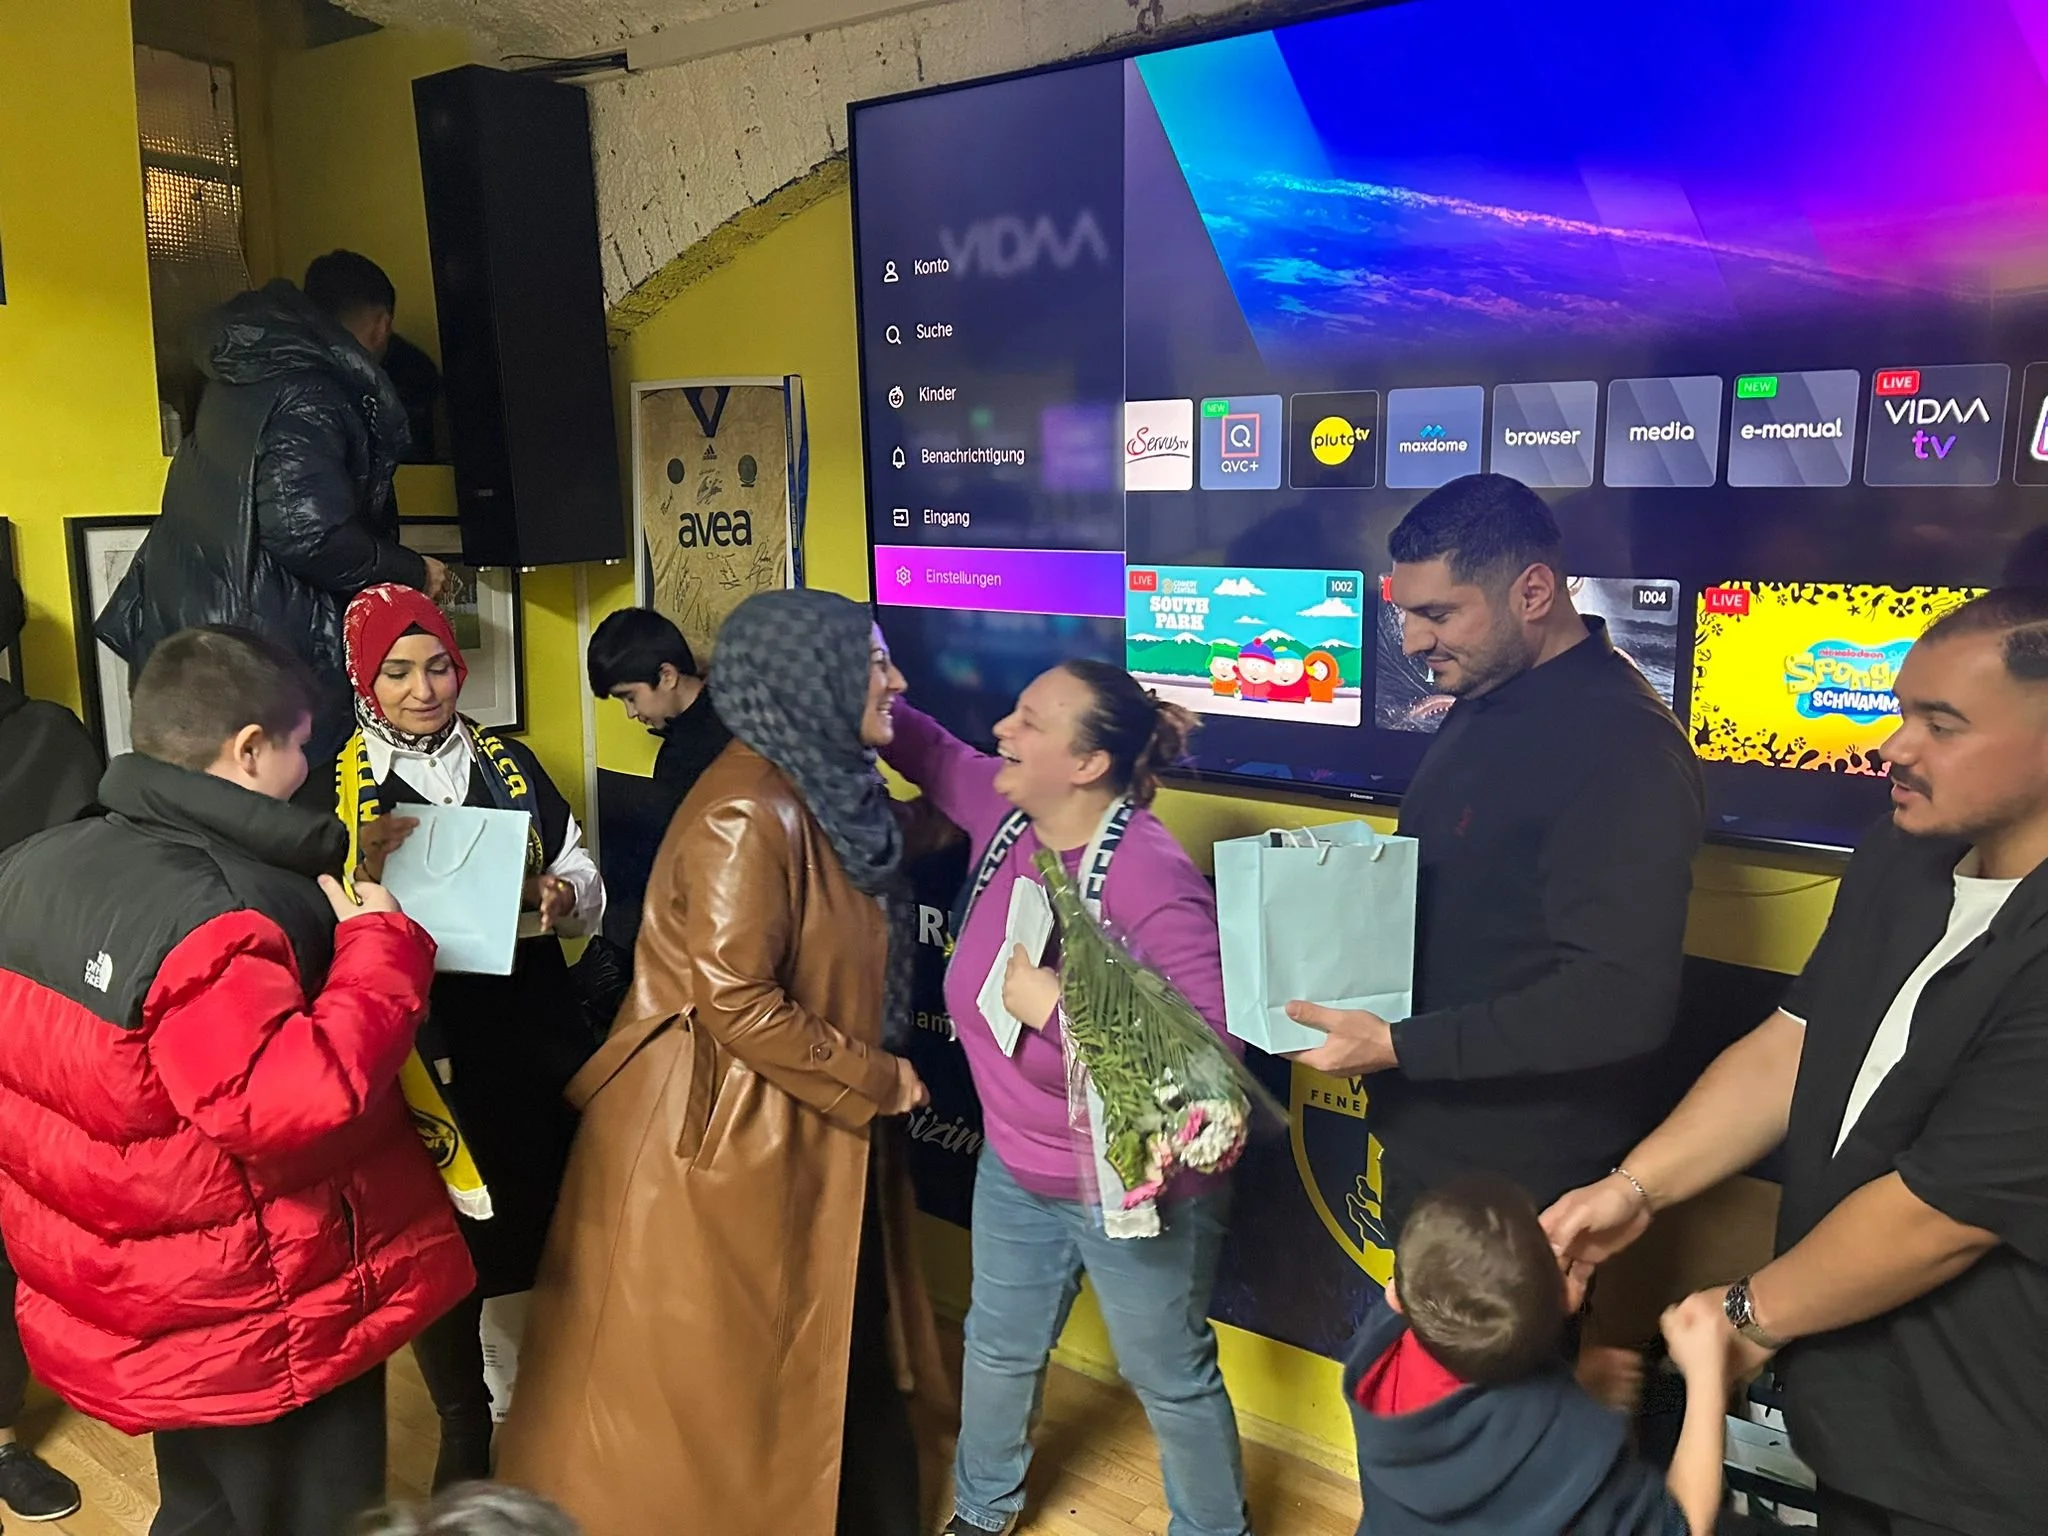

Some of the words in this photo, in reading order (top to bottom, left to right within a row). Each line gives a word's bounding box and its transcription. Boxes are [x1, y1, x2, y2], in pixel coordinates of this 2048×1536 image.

[914, 257, 949, 275] Konto
[916, 323, 953, 340] Suche
[1743, 380, 1772, 393] NEW
[1882, 375, 1913, 390] LIVE
[919, 385, 957, 402] Kinder
[1206, 403, 1226, 413] NEW
[1230, 424, 1251, 448] Q
[1504, 428, 1582, 447] browser
[1628, 421, 1695, 442] media
[1740, 418, 1843, 441] e-manual
[1314, 433, 1356, 450] pluto
[1399, 437, 1468, 453] maxdome
[1911, 429, 1957, 460] tv
[921, 446, 1026, 466] Benachrichtigung
[1221, 460, 1259, 473] QVC+
[923, 509, 970, 528] Eingang
[679, 509, 752, 549] avea
[926, 569, 1002, 587] Einstellungen
[1133, 575, 1153, 586] LIVE
[1330, 581, 1353, 593] 1002
[1150, 595, 1210, 615] SOUTH
[1638, 590, 1667, 605] 1004
[1712, 592, 1743, 608] LIVE
[1155, 612, 1205, 631] PARK
[1818, 647, 1885, 659] nickelodeon
